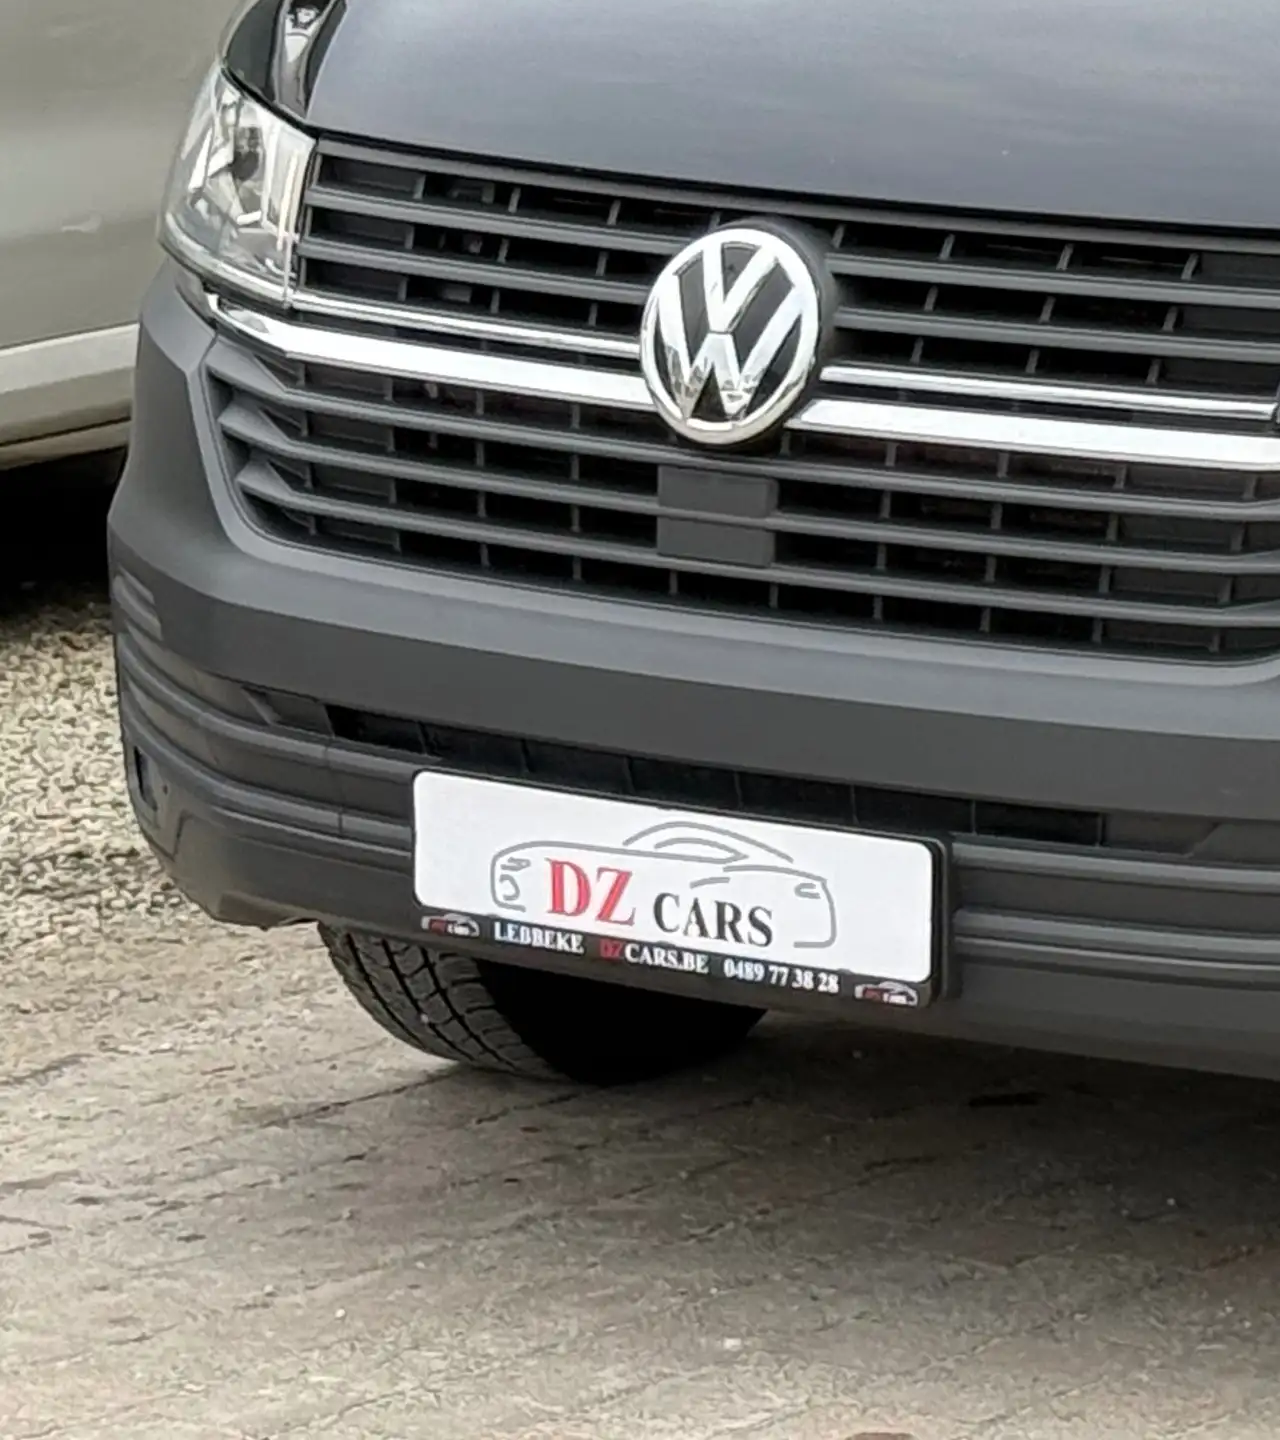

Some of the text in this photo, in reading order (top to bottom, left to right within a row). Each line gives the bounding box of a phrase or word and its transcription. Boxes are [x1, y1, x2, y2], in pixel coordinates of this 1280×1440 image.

[544, 857, 774, 948] DZ CARS
[493, 918, 585, 955] LEBBEKE
[723, 957, 765, 982] 0489
[768, 962, 791, 986] 77
[791, 964, 815, 990] 38
[817, 969, 840, 994] 28
